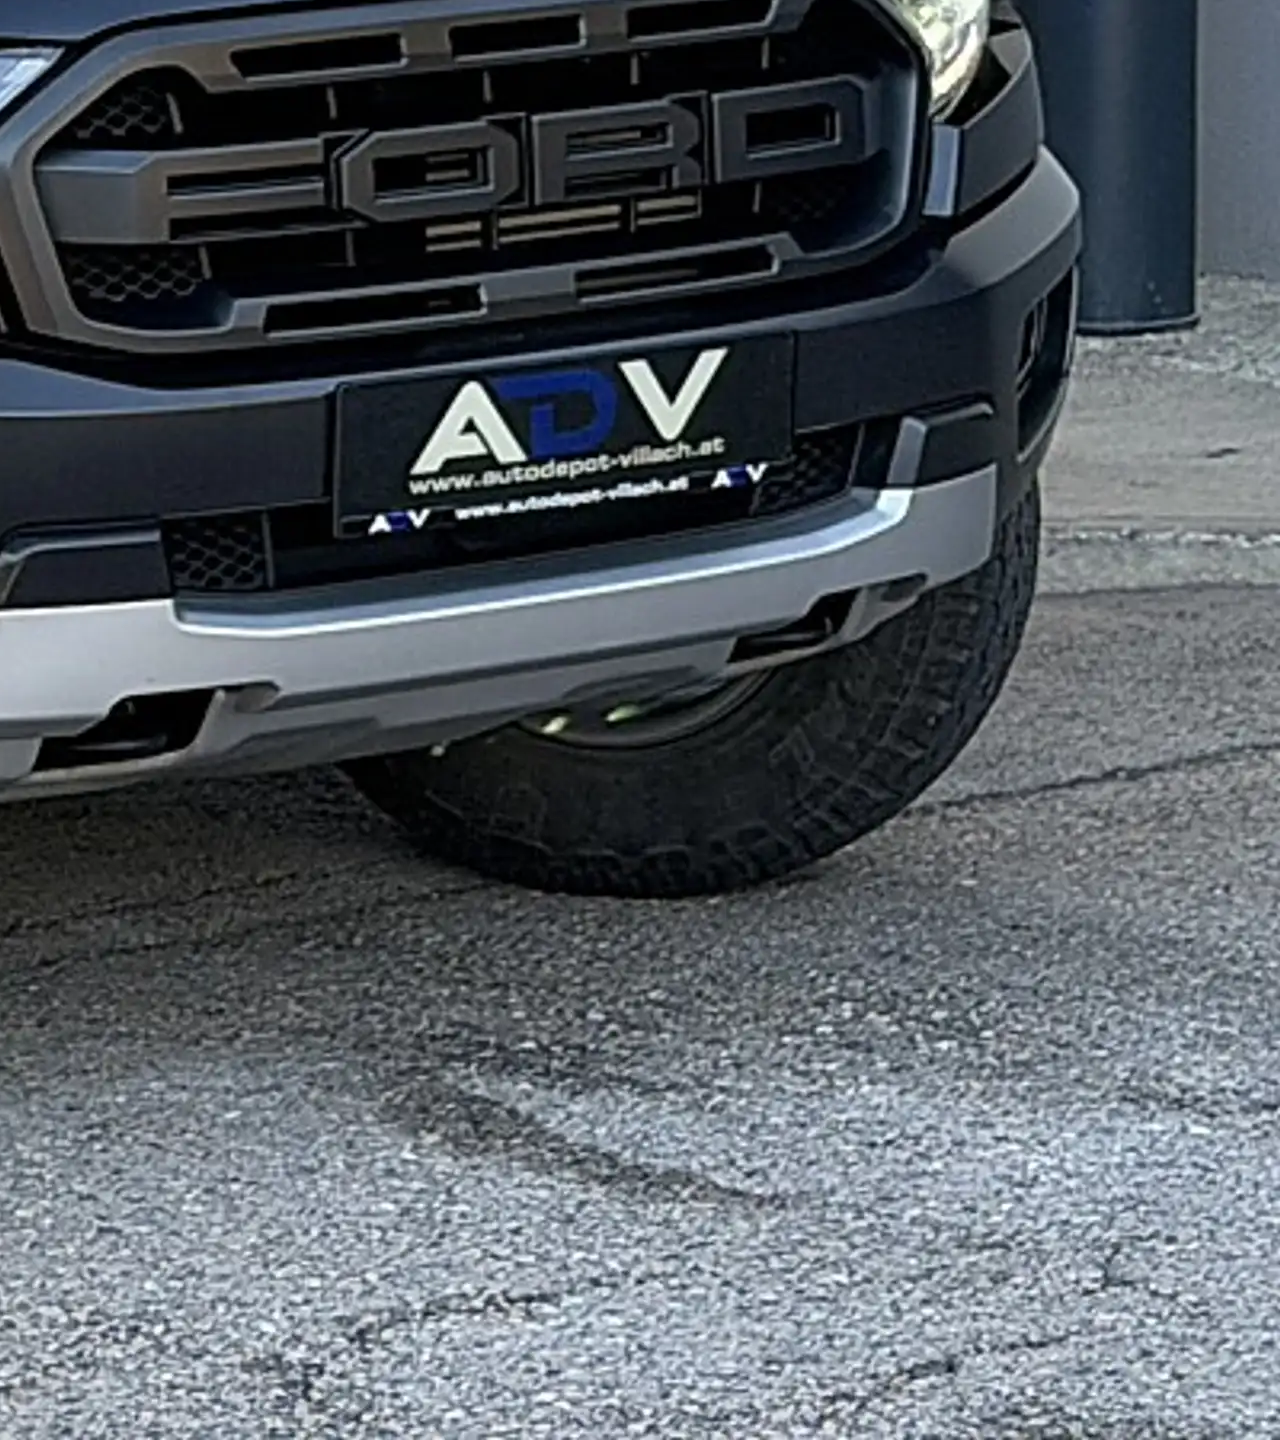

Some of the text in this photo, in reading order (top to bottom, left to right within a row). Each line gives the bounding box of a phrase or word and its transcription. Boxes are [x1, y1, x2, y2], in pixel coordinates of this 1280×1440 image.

[30, 77, 880, 244] FORD
[408, 347, 729, 475] ADV
[408, 436, 726, 496] www.autodepot-villach.at
